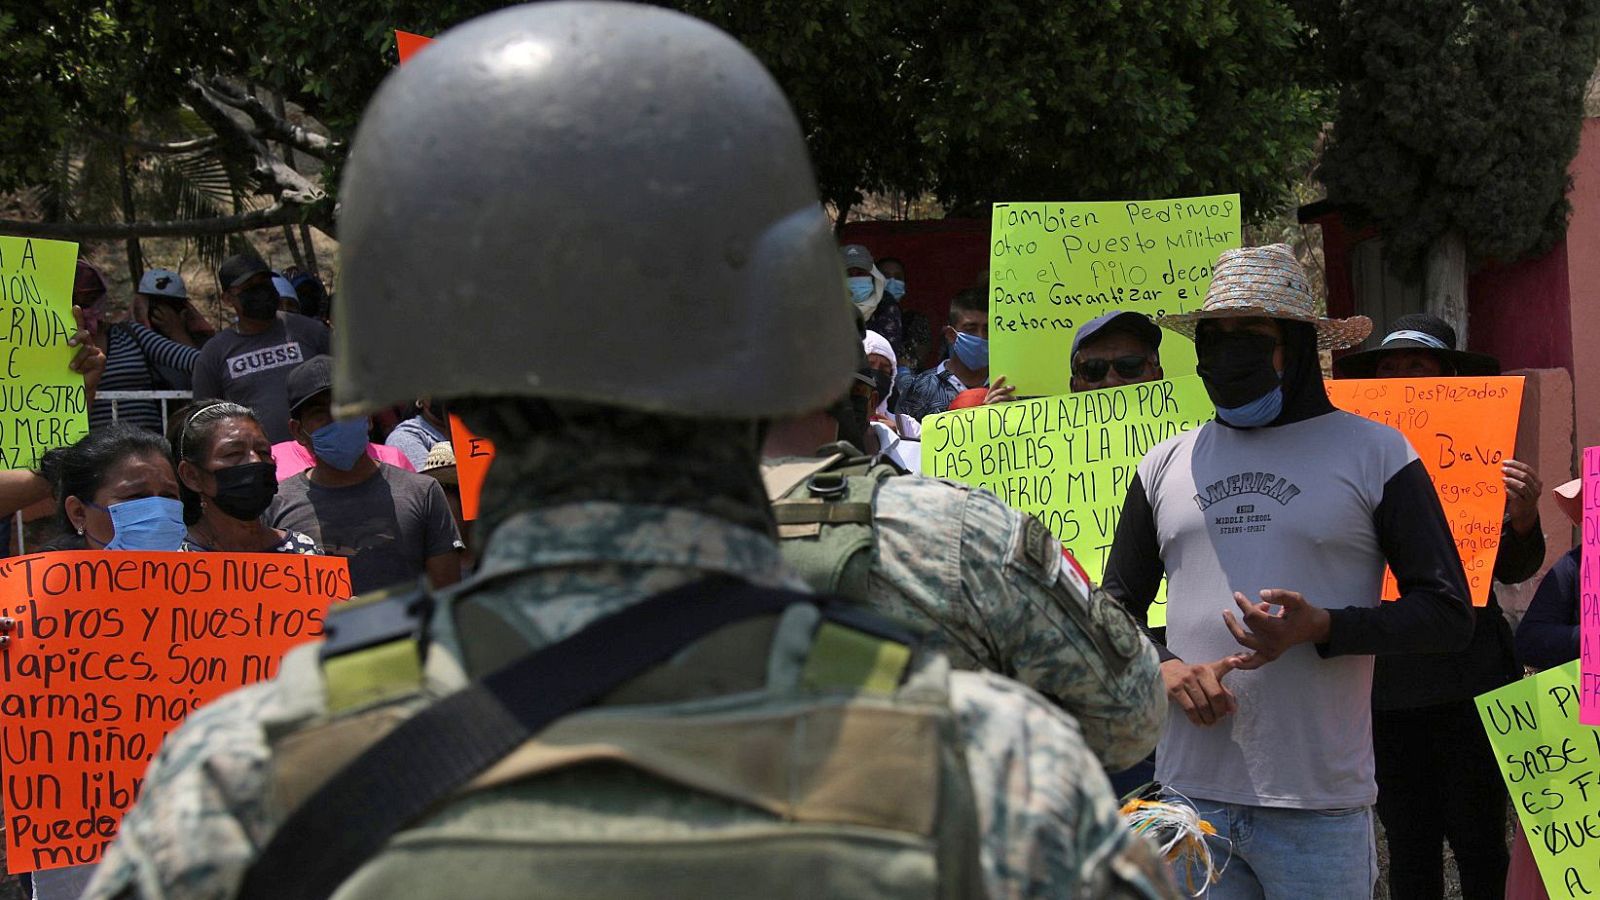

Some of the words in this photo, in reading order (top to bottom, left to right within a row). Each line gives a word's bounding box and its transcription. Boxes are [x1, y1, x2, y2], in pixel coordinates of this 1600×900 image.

[996, 204, 1100, 233] Tambien
[1126, 200, 1234, 226] Pedimos
[1166, 225, 1235, 251] Militar
[994, 270, 1017, 282] en
[1036, 261, 1061, 283] el
[1049, 283, 1163, 306] Garantizar
[994, 312, 1074, 332] Retorno
[232, 346, 299, 373] GUESS
[934, 412, 976, 453] SOY
[988, 390, 1128, 440] DEZPLAZADO
[1136, 380, 1179, 419] POR
[933, 446, 973, 479] LAS
[979, 436, 1054, 476] BALAS
[1063, 432, 1075, 466] Y
[1085, 426, 1112, 463] LA
[1067, 471, 1097, 505] MI
[1193, 472, 1301, 512] AMERICAN
[1215, 516, 1244, 525] MIDDLE
[1247, 514, 1272, 523] SCHOOL
[222, 558, 352, 602] nuestros
[171, 602, 326, 643] nuestros
[3, 643, 158, 689] lápices,
[168, 643, 227, 685] Son
[1, 691, 123, 724] armas
[1486, 698, 1538, 736] UN
[4, 725, 54, 766] Un
[1506, 737, 1588, 783] SABE
[1521, 788, 1564, 815] ES
[1563, 866, 1593, 898] A
